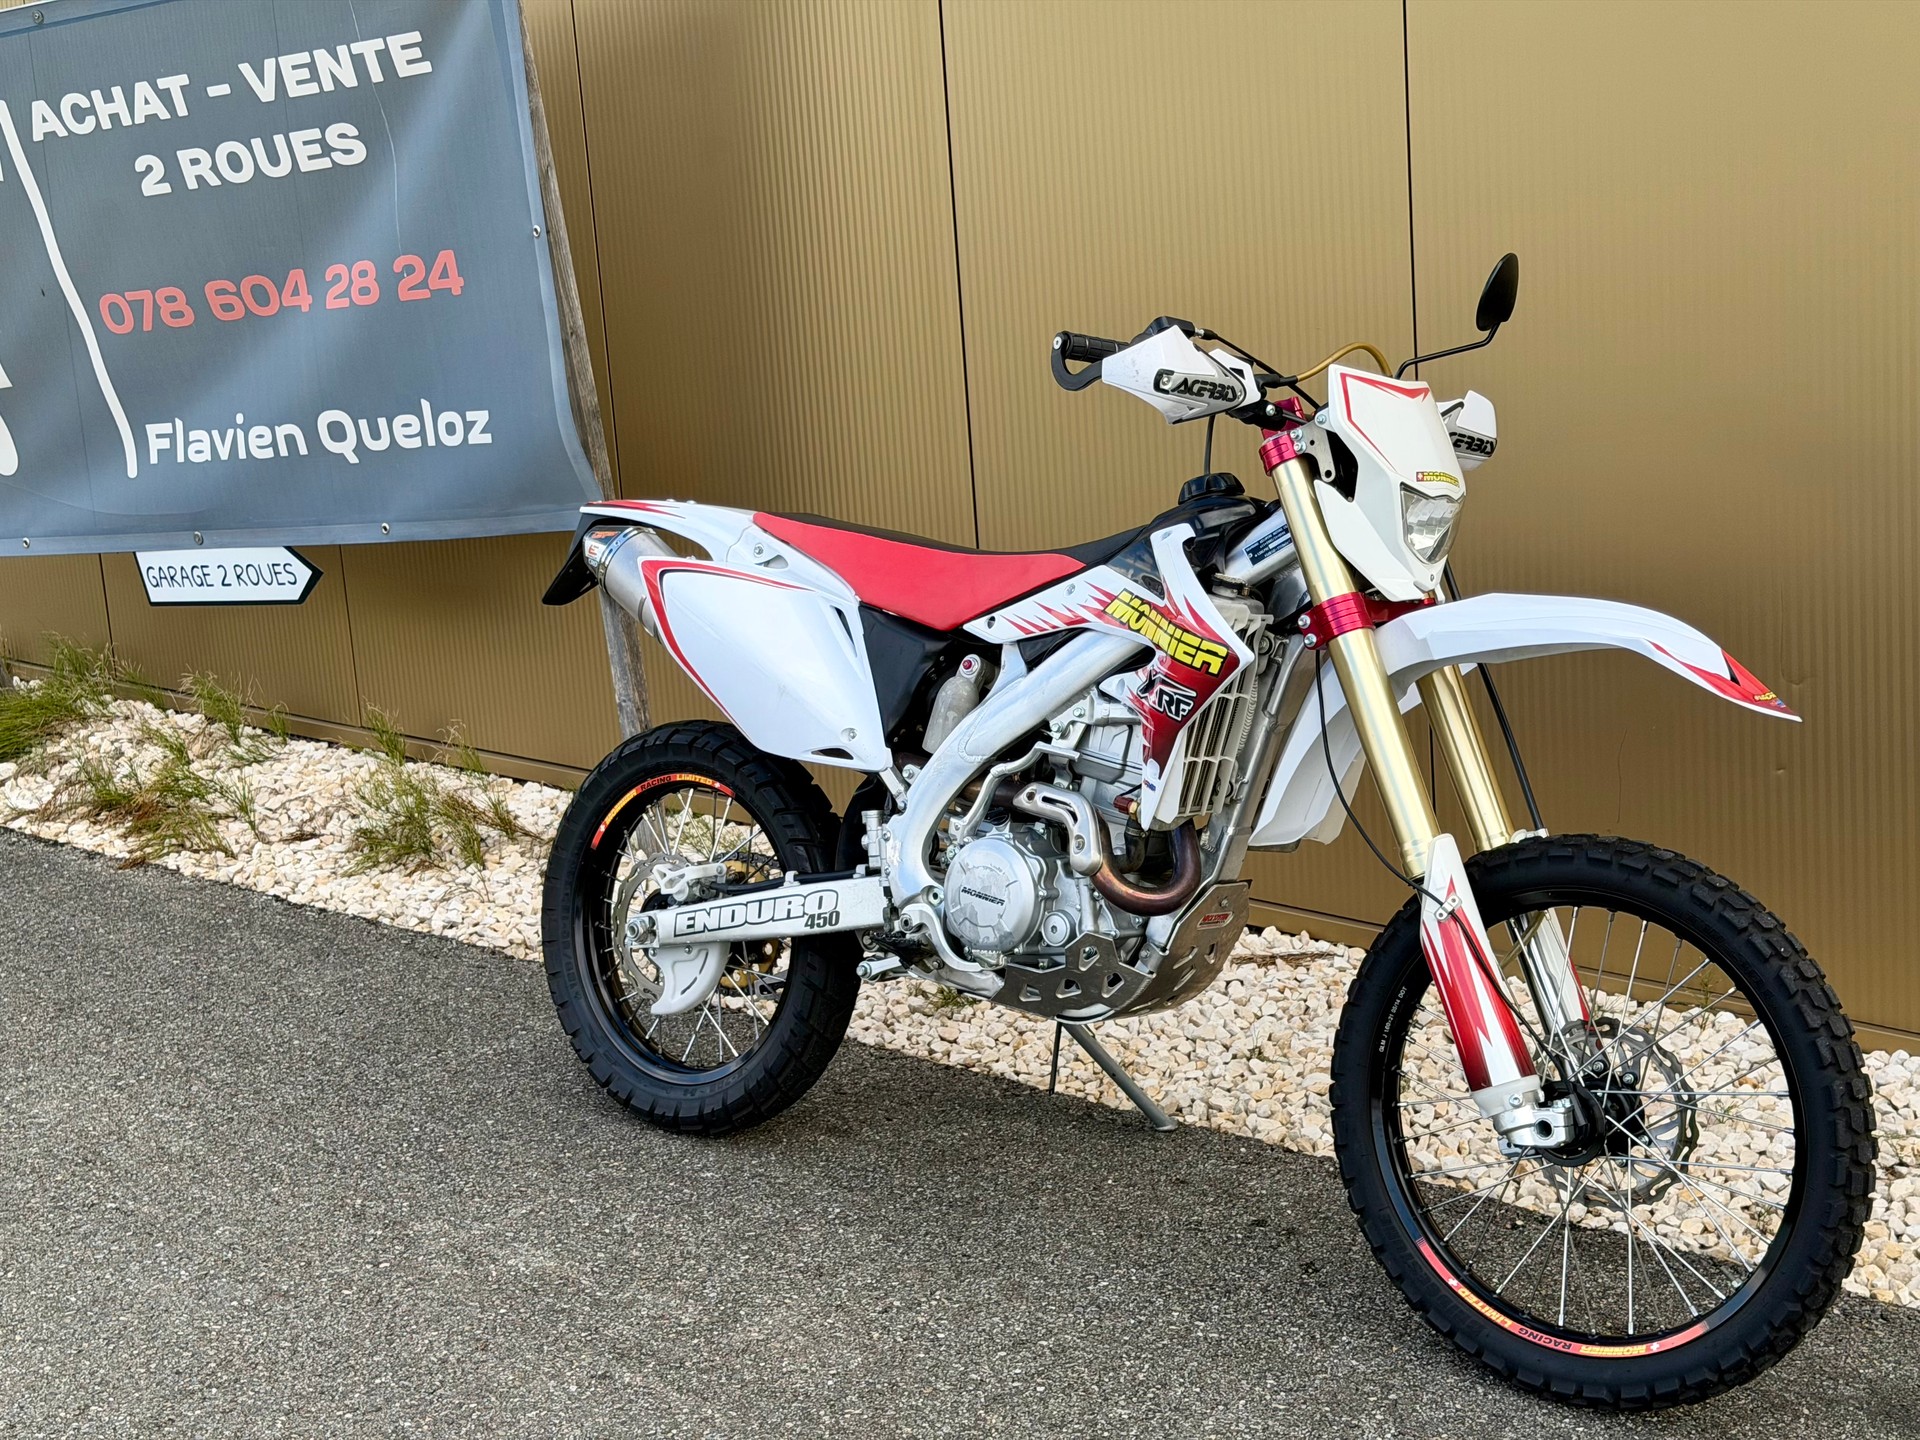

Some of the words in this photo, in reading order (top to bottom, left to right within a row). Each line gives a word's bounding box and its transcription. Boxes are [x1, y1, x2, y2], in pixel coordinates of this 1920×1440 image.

[31, 74, 190, 142] ACHAT
[237, 30, 433, 103] VENTE
[134, 154, 172, 197] 2
[177, 122, 367, 190] ROUES
[99, 287, 195, 335] 078
[204, 268, 313, 321] 604
[325, 260, 380, 310] 28
[393, 249, 465, 302] 24
[145, 412, 309, 465] Flavien
[317, 398, 493, 464] Queloz
[146, 564, 215, 588] GARAGE
[216, 564, 232, 587] 2
[233, 562, 298, 587] ROUES
[1103, 588, 1229, 677] MONNIER
[640, 775, 672, 792] RACING
[675, 772, 713, 787] LIMITED
[674, 889, 839, 938] ENDURO
[804, 909, 841, 930] 450
[961, 886, 1006, 906] MONNIER
[1457, 1286, 1513, 1329] LIMITED
[1518, 1327, 1574, 1351] RACING
